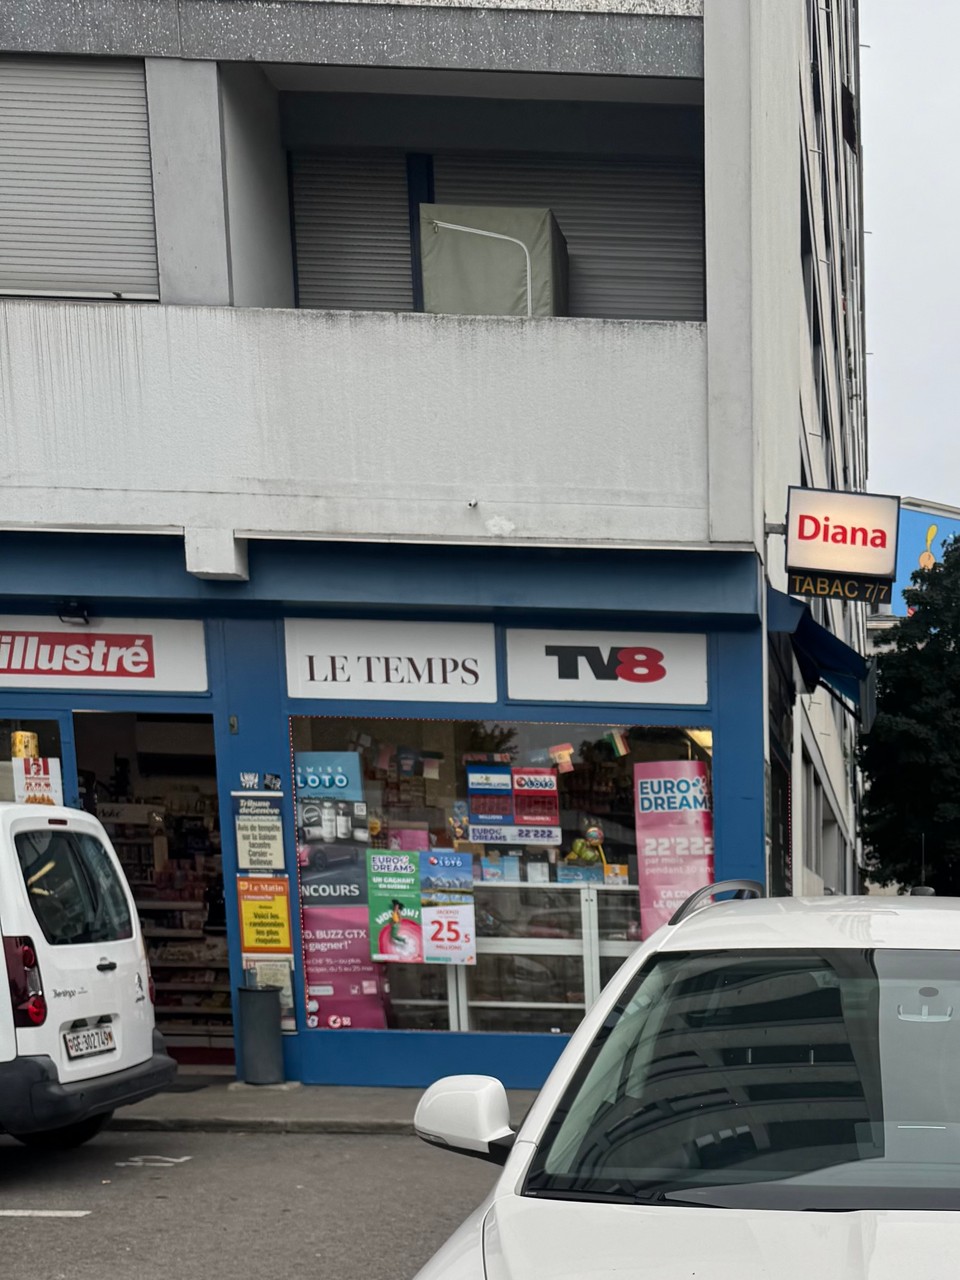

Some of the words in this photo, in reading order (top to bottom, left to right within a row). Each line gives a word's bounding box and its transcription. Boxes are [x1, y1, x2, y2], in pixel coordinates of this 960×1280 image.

[797, 514, 887, 549] Diana
[792, 575, 859, 598] TABAC
[864, 583, 889, 603] 7/7
[0, 635, 149, 673] illustré
[305, 655, 351, 683] LE
[356, 655, 480, 686] TEMPS
[545, 645, 667, 684] TV8
[296, 775, 348, 788] LOTO
[639, 779, 690, 796] EURO
[240, 799, 270, 808] Tribune
[372, 856, 400, 865] EURO
[372, 864, 415, 872] DREAMS
[645, 866, 682, 875] pendant
[249, 883, 259, 891] Le
[260, 883, 284, 892] Matin
[301, 884, 360, 897] NCOURS
[316, 929, 344, 939] BUZZ
[345, 929, 367, 938] GTX
